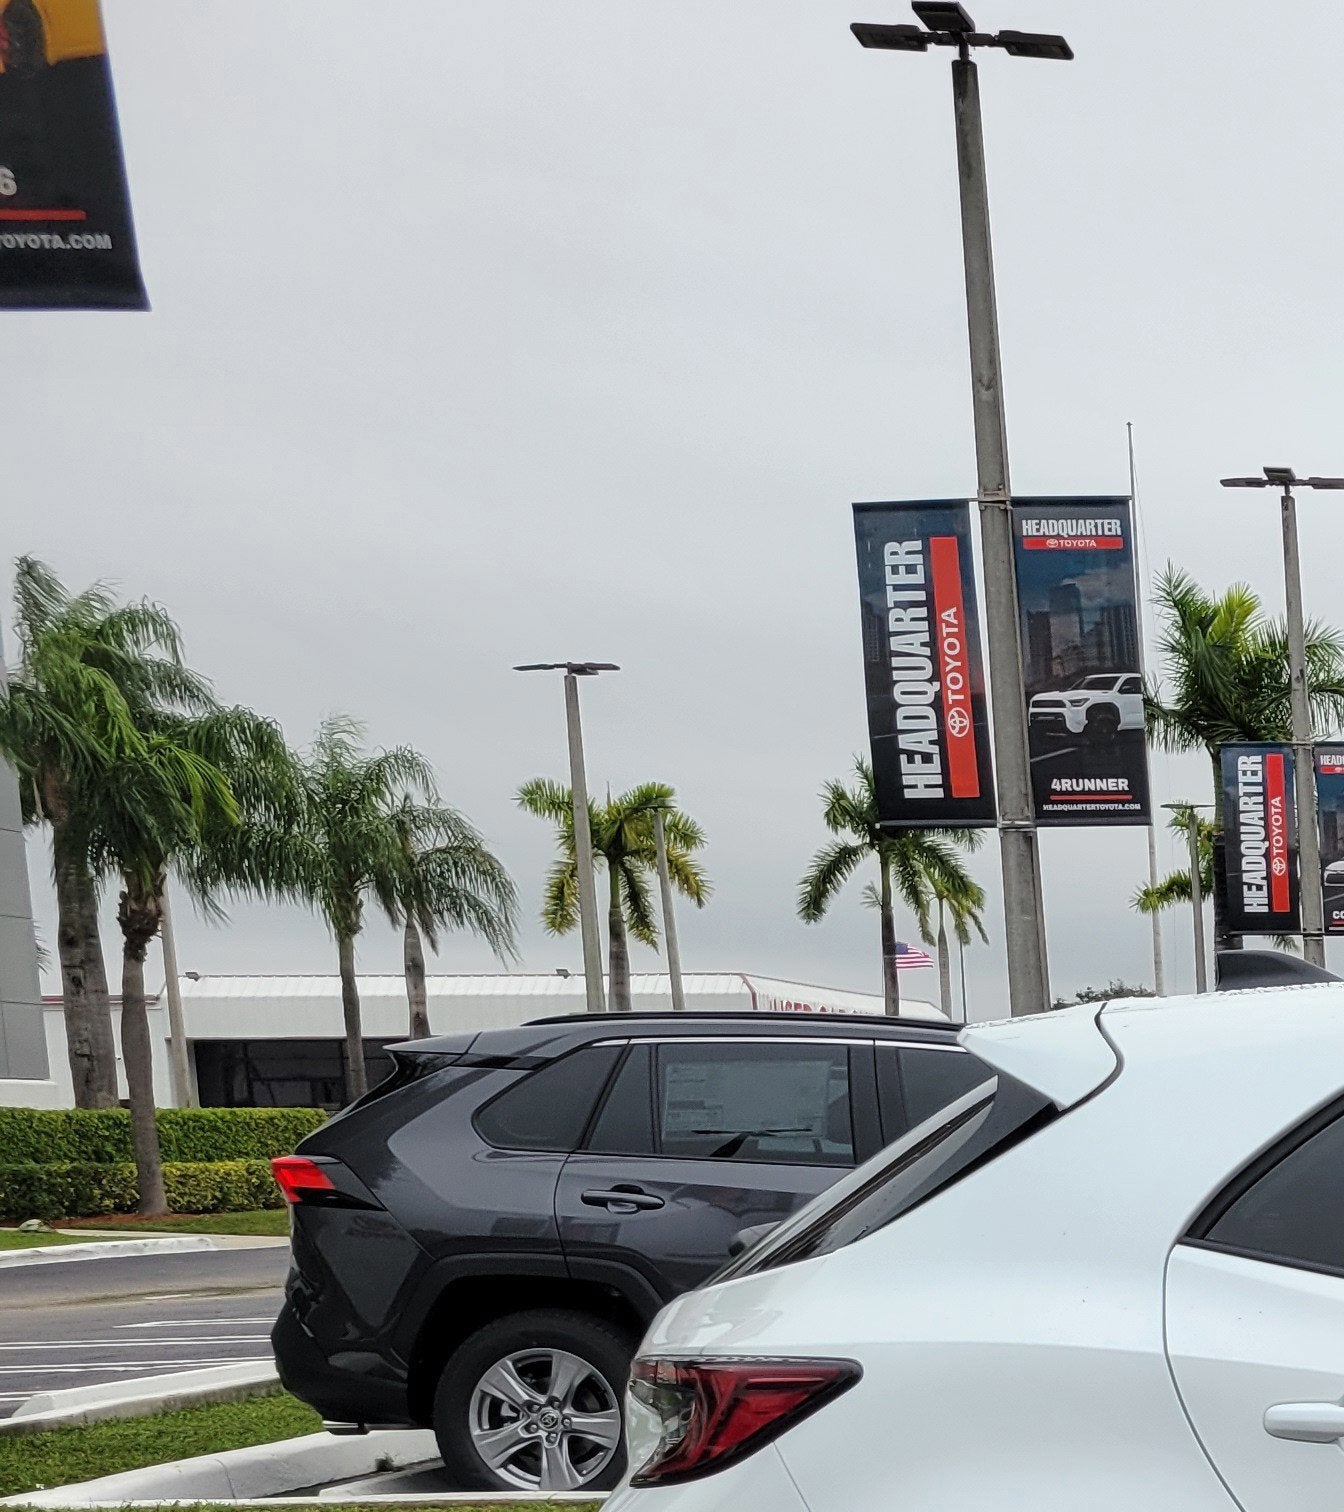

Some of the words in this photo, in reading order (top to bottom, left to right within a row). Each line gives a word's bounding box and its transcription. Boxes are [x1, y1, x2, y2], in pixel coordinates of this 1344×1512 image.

[0, 233, 113, 250] OYOTA.COM
[1021, 519, 1122, 538] HEADQUARTER
[1059, 539, 1097, 548] TOYOTA
[940, 606, 965, 704] TOYOTA
[884, 539, 945, 799] HEADQUARTER
[1050, 778, 1130, 791] 4RUNNER
[1042, 803, 1141, 811] HEADQUARTERTOYOTA.COM
[1237, 755, 1270, 913] HEADQUARTER
[1271, 796, 1284, 856] TOYOTA
